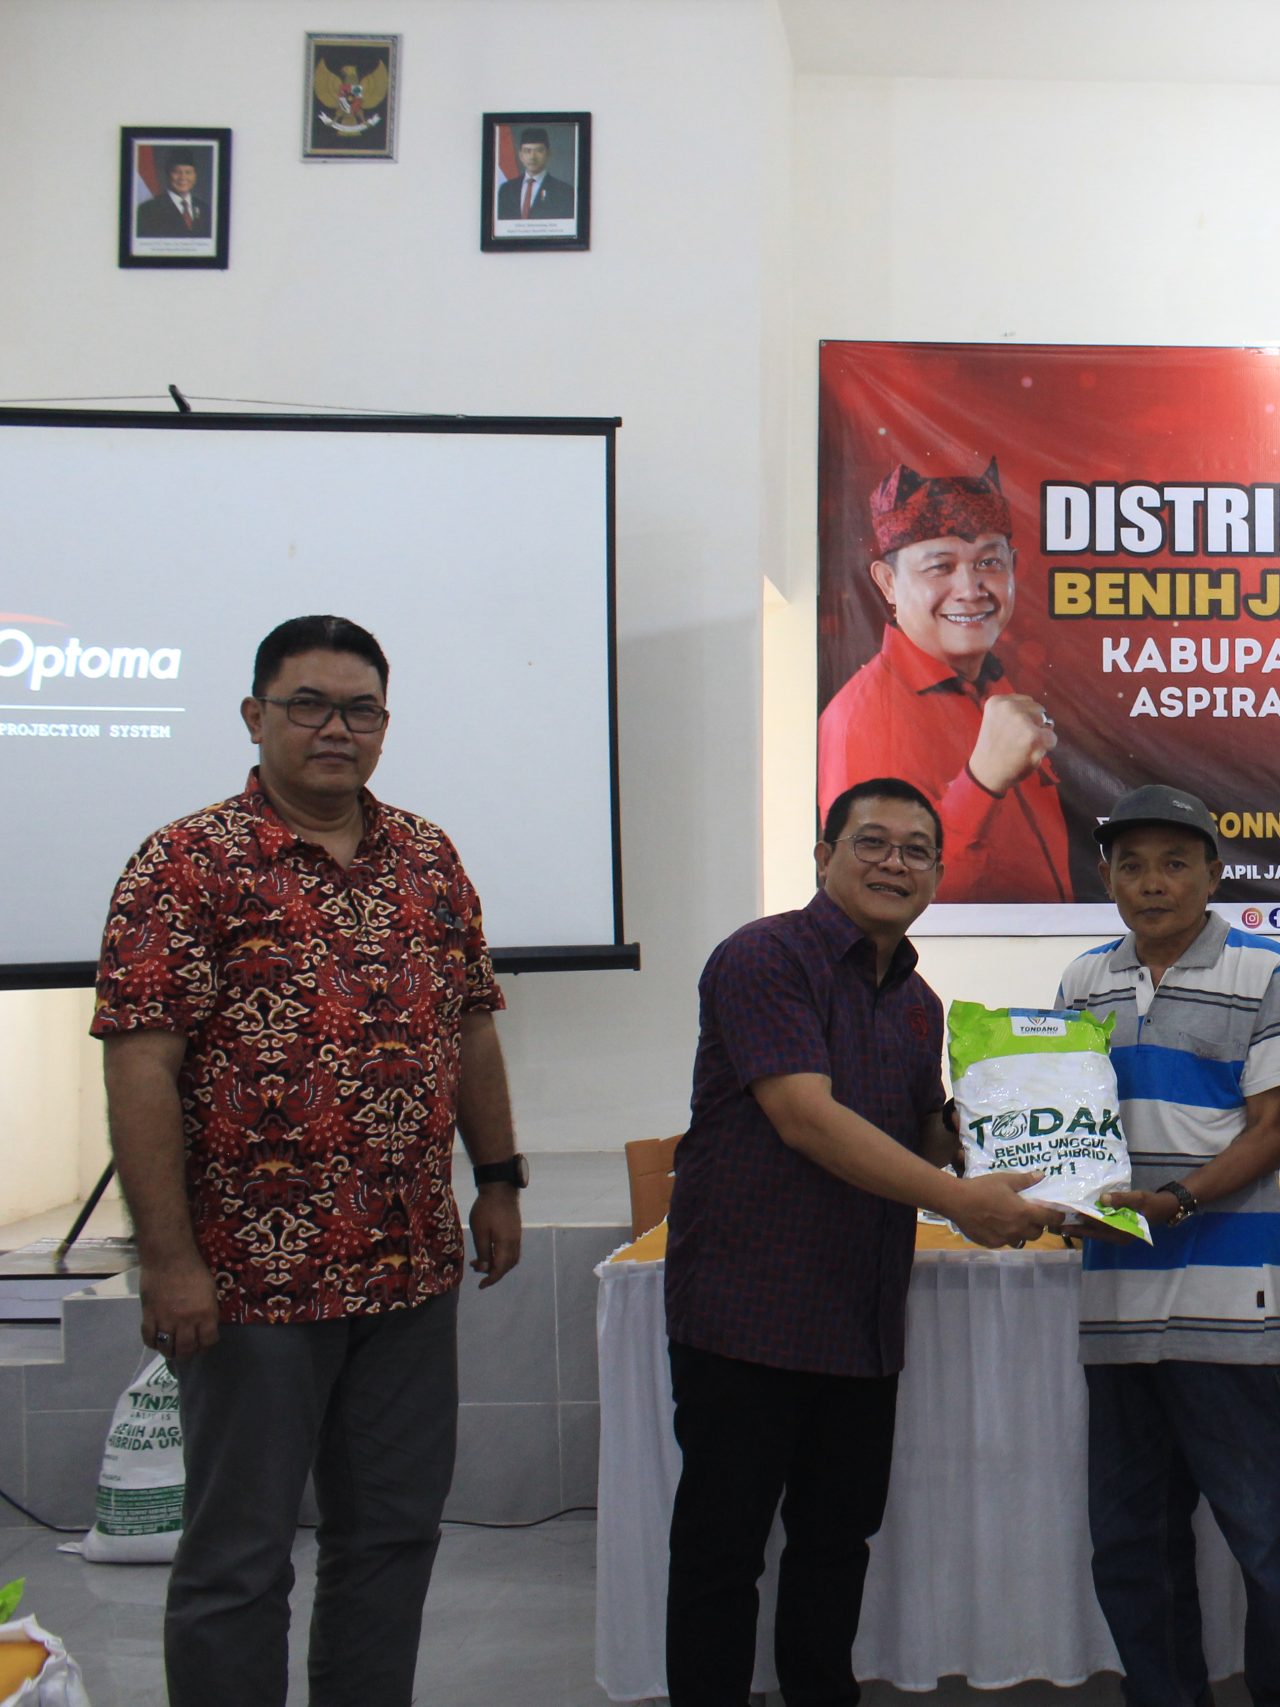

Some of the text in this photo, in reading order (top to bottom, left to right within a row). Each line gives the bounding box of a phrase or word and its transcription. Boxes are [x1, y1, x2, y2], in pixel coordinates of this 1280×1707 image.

[1053, 572, 1236, 616] BENIH
[0, 628, 182, 691] Optoma
[109, 724, 171, 738] SYSTEM
[1221, 864, 1260, 880] APIL
[988, 1148, 1117, 1170] JAGUNG HIBRIDA
[994, 1137, 1107, 1159] BENIH UNGGUL
